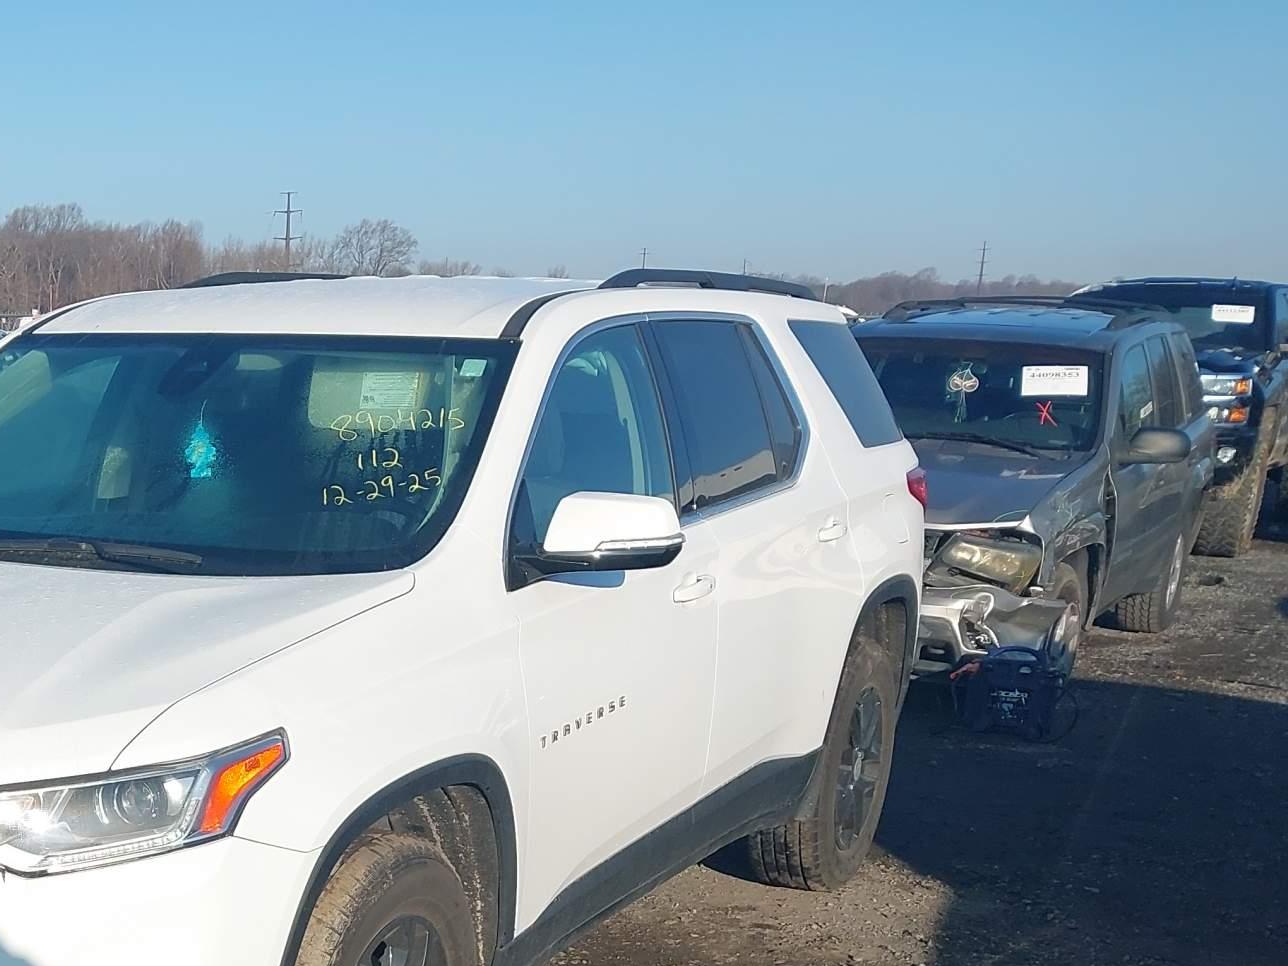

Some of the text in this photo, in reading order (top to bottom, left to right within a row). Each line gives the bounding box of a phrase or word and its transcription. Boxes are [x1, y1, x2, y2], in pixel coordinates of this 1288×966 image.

[330, 407, 465, 442] 8904215
[357, 447, 403, 471] 112
[322, 467, 442, 507] 12-29-25
[539, 695, 626, 749] TRAVERSE
